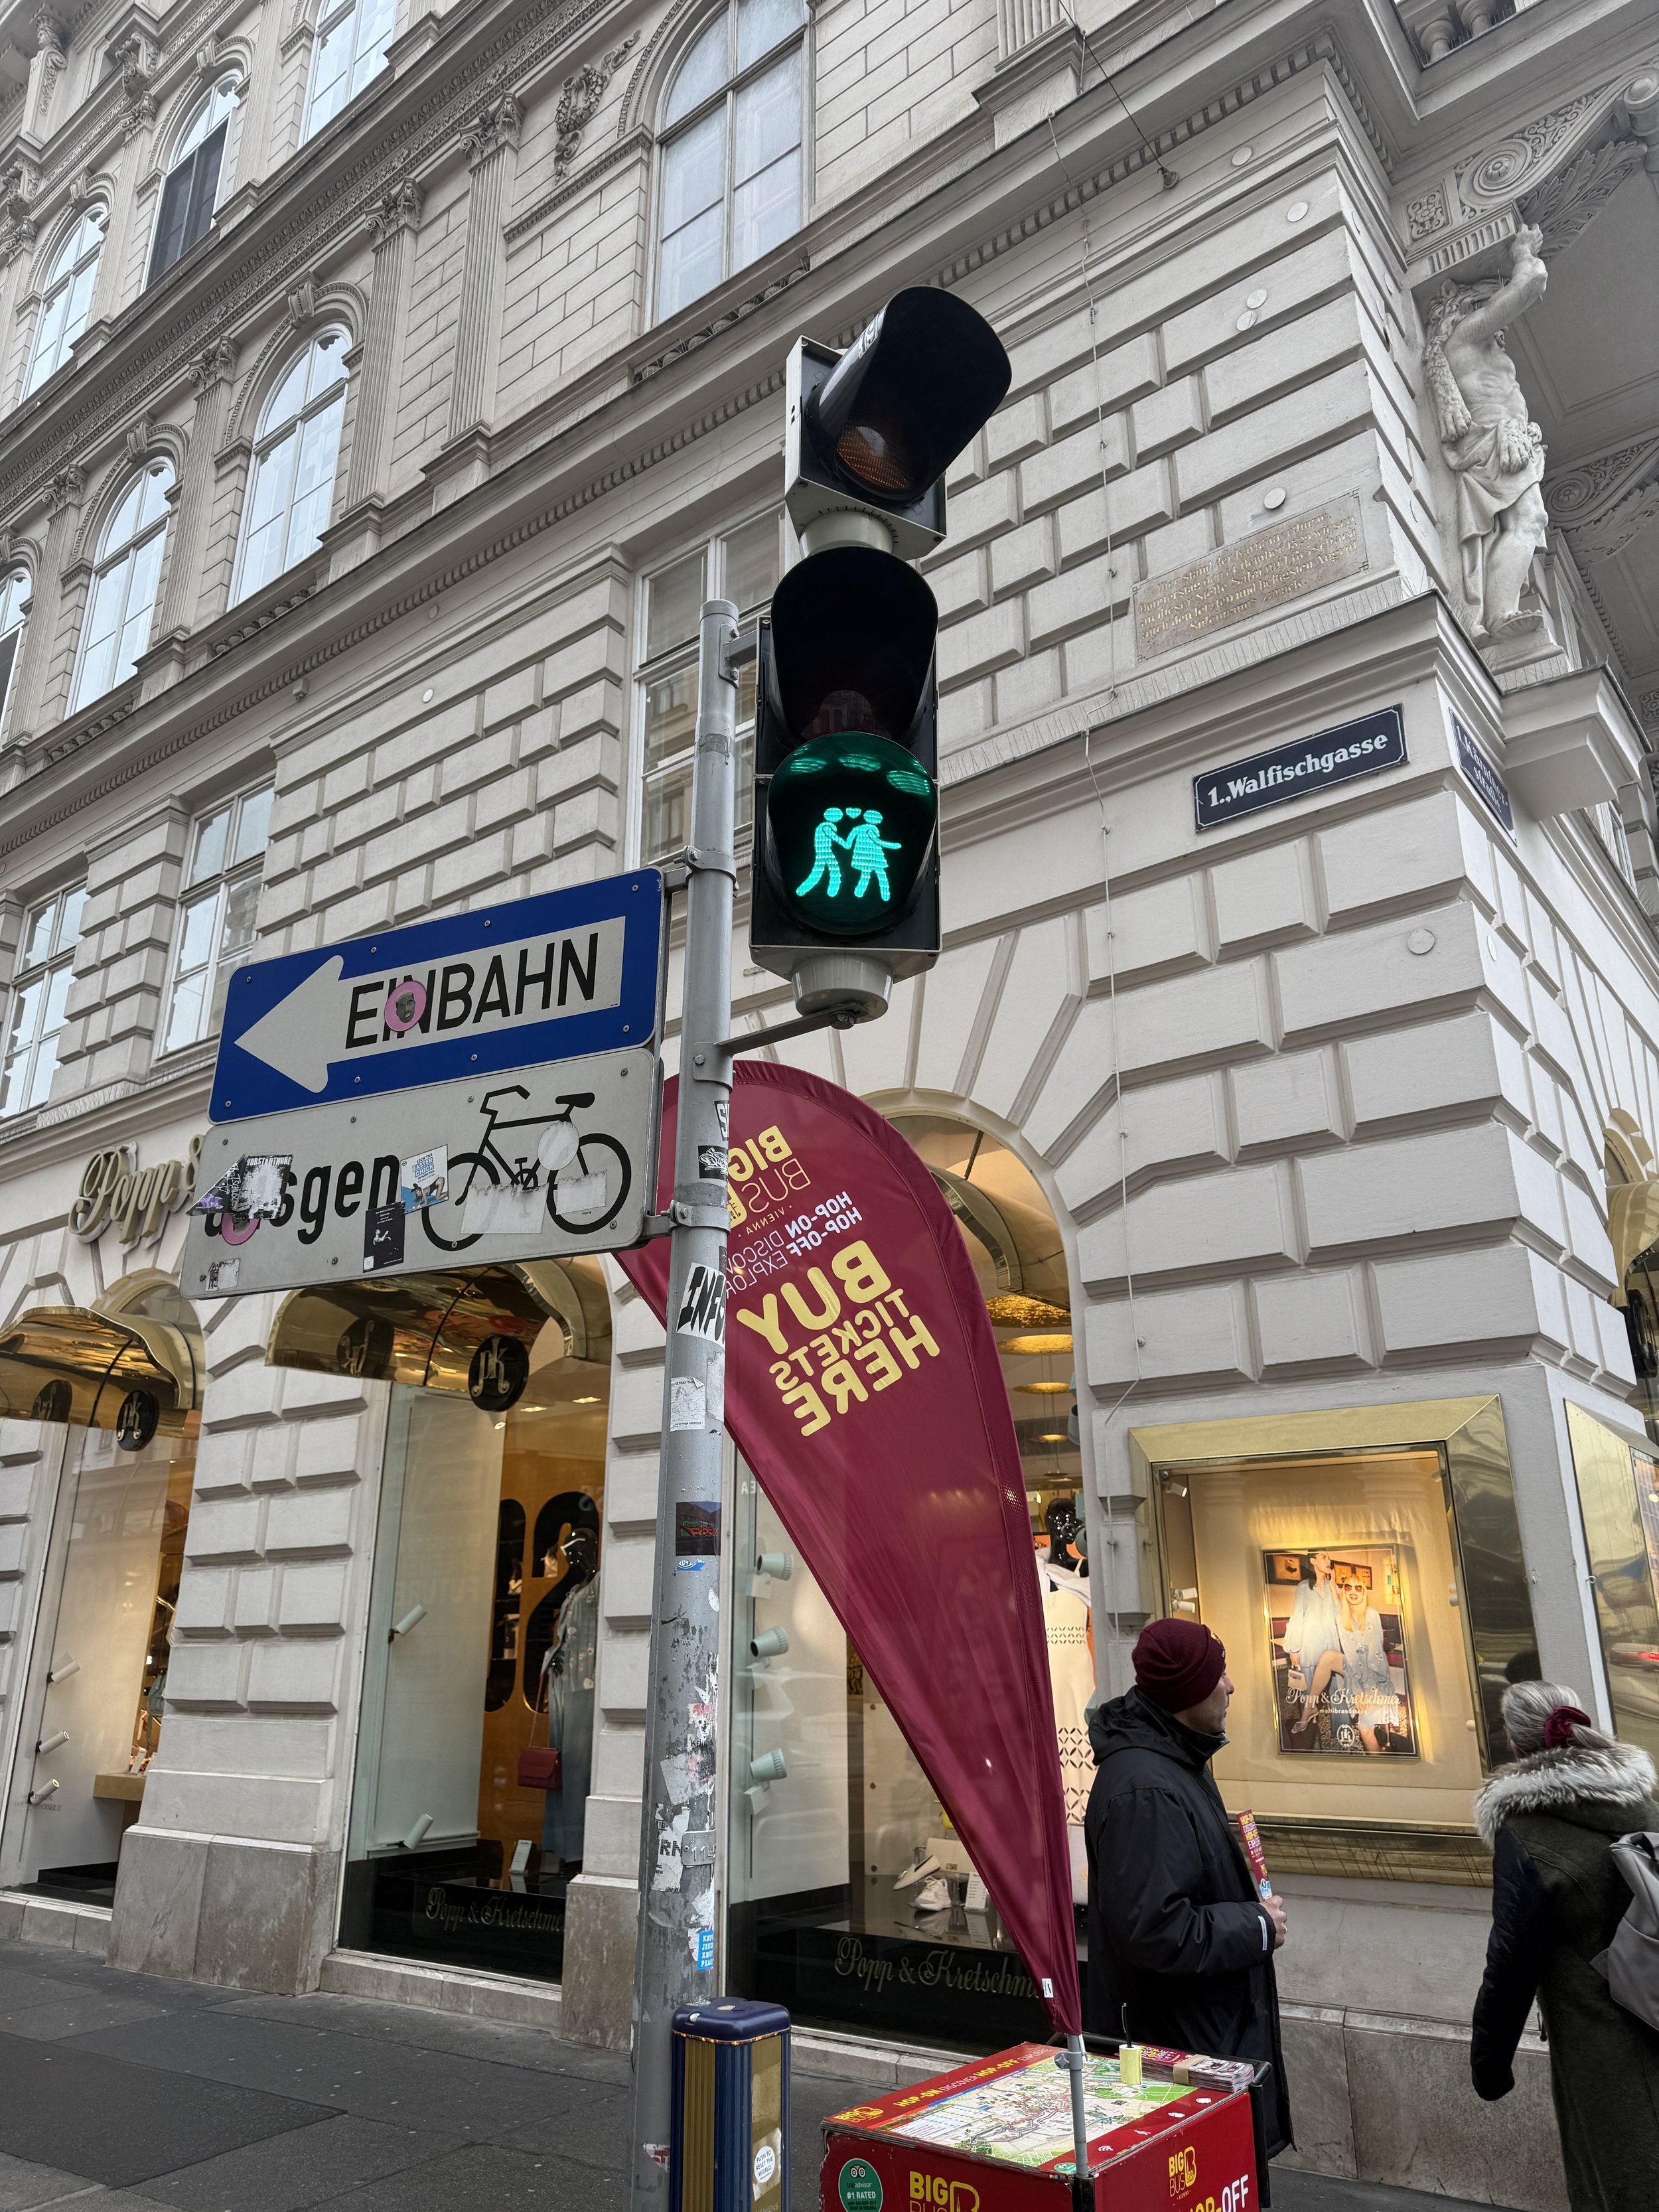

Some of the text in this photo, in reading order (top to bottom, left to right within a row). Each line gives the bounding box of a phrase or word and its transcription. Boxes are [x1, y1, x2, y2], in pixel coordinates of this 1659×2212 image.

[413, 1157, 433, 1171] EASTER
[415, 1163, 434, 1177] CHICK
[68, 1145, 180, 1244] Popp
[204, 1153, 399, 1246] sgen
[1285, 1687, 1402, 1709] Popp & Kretschmer
[425, 1887, 564, 1932] Popp & Kretschme
[833, 1936, 1040, 1999] Popp & Kretschm
[893, 2089, 943, 2108] HOP-ON
[940, 2075, 979, 2092] DISCOVER
[974, 2059, 1021, 2078] HOP-OFF
[833, 2111, 861, 2120] BIG
[846, 2114, 873, 2123] BUS
[756, 2160, 766, 2170] RESET
[757, 2153, 766, 2163] PUSH
[1168, 2151, 1185, 2177] BIG
[847, 2181, 873, 2190] tripadvisor
[856, 2191, 876, 2199] RATED
[910, 2170, 948, 2205] BIG
[1169, 2172, 1185, 2197] BUS
[1190, 2174, 1248, 2212] P-OFF
